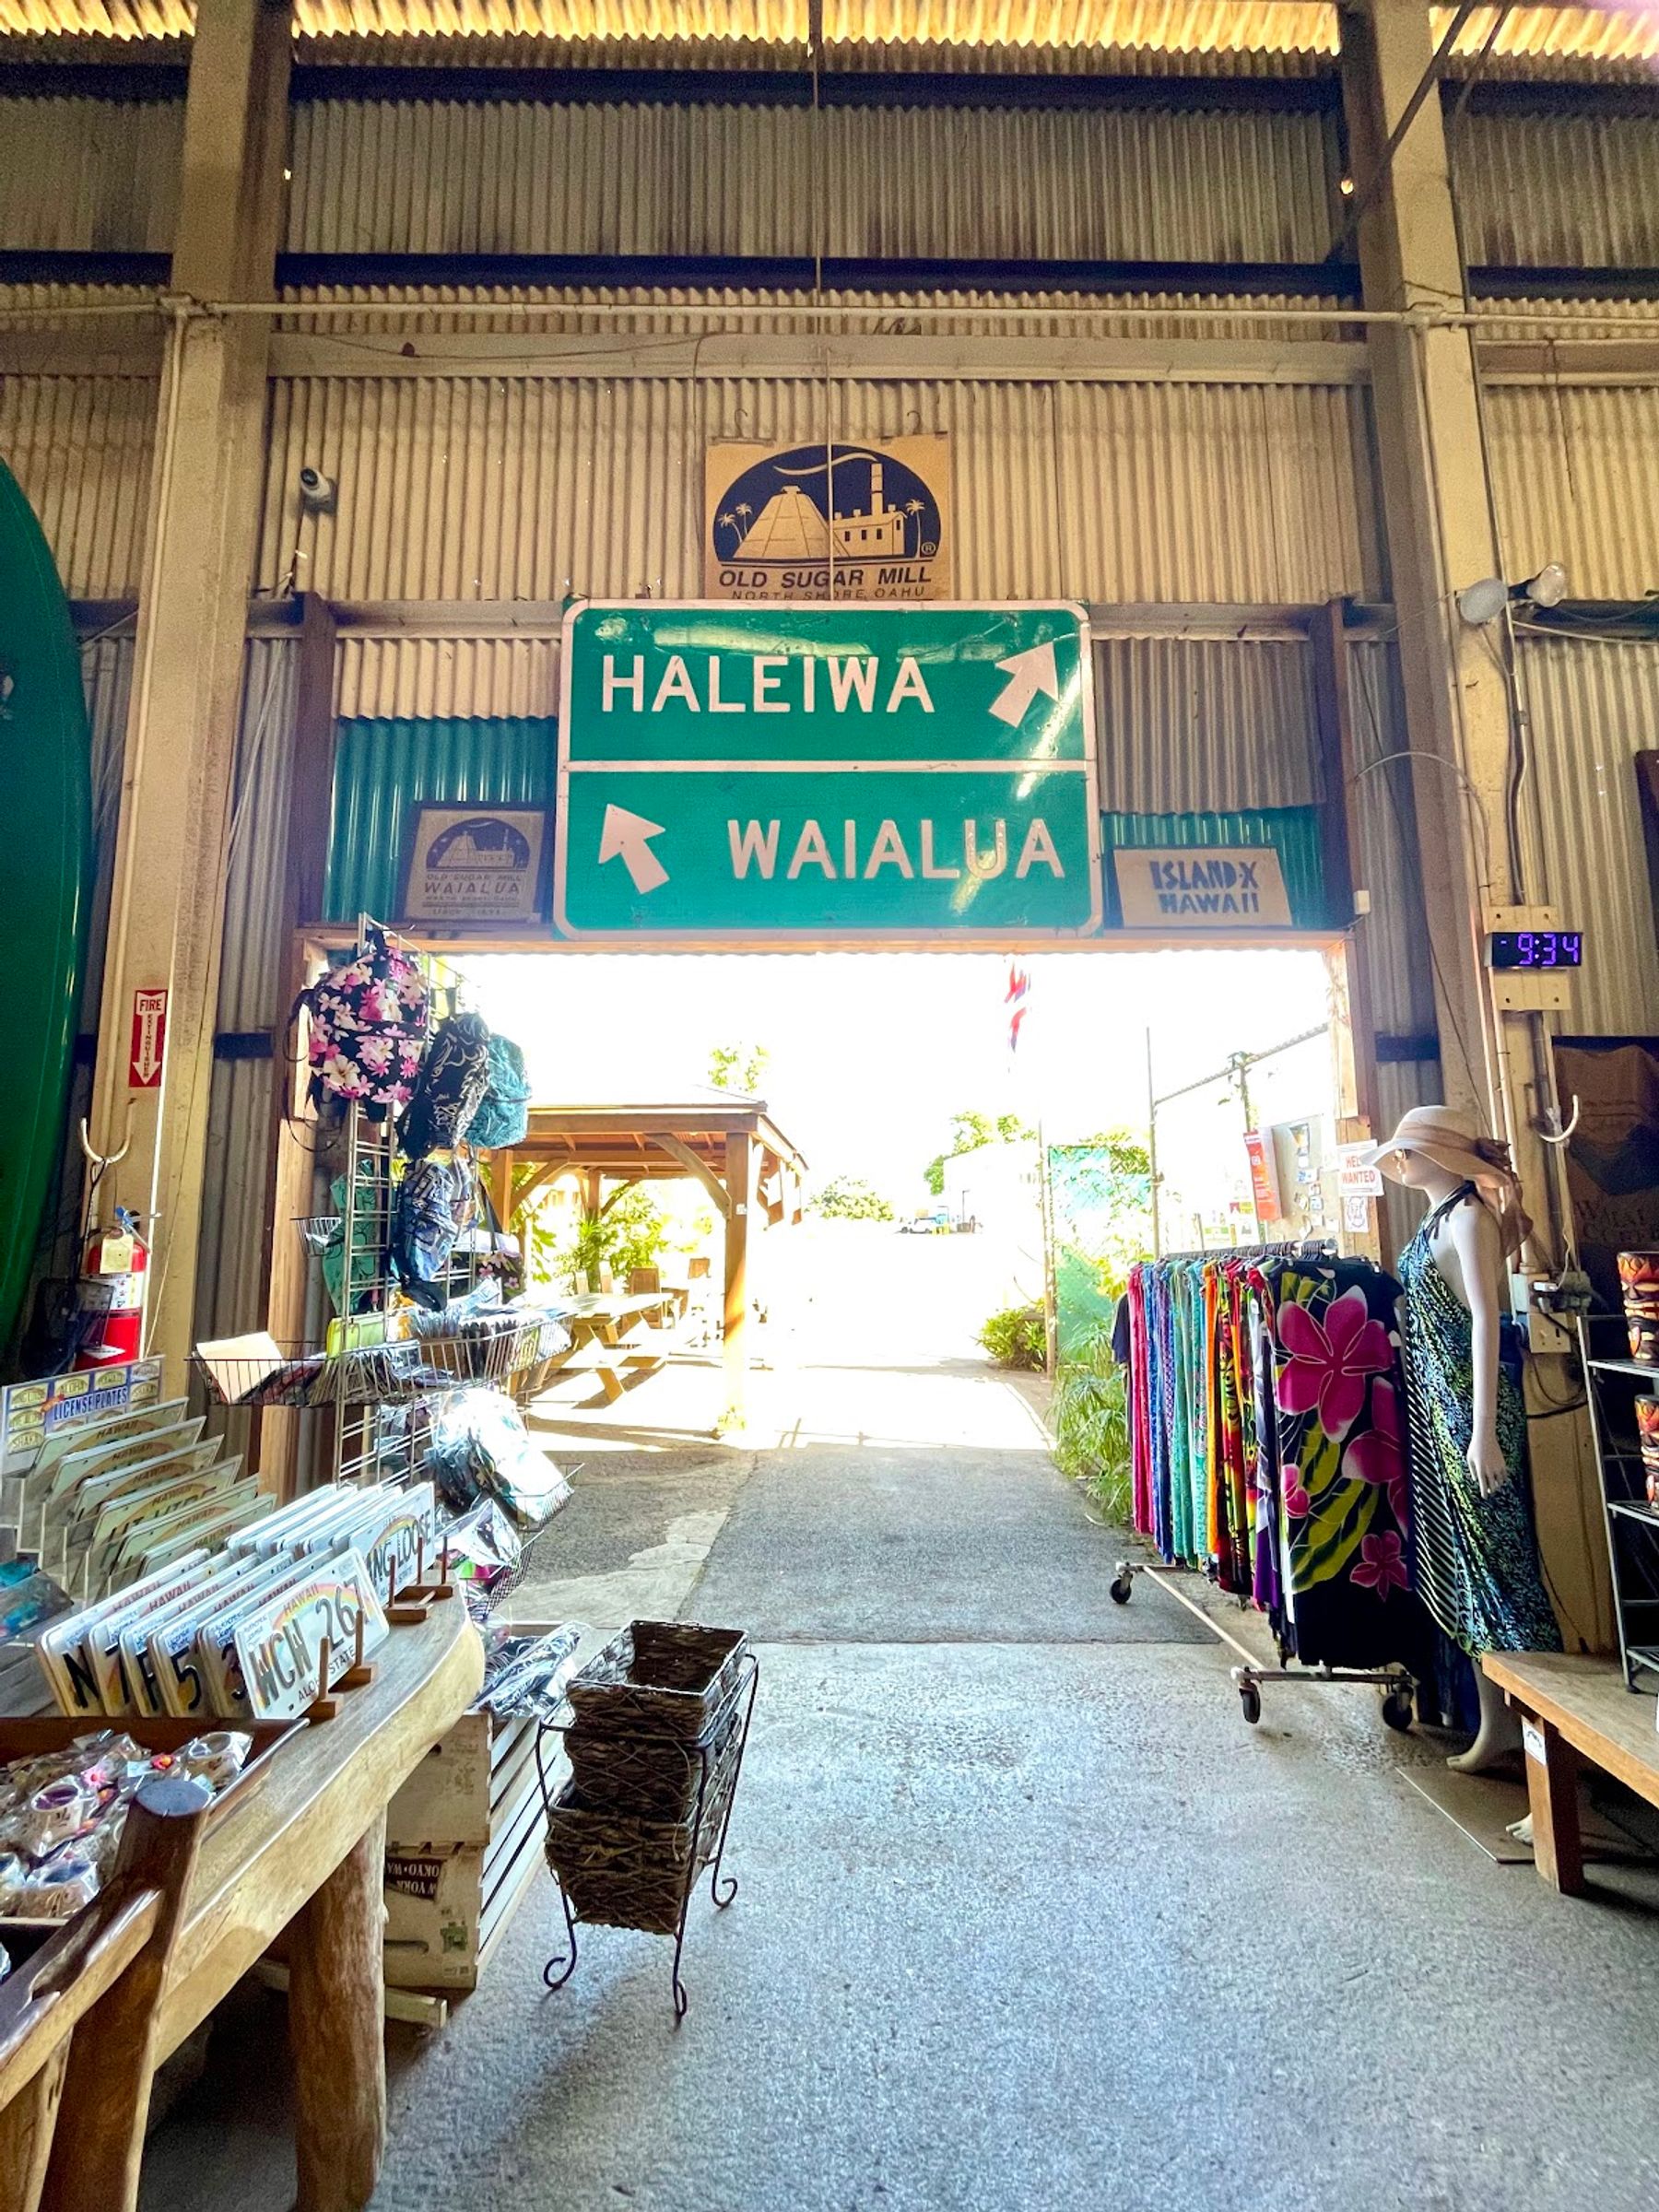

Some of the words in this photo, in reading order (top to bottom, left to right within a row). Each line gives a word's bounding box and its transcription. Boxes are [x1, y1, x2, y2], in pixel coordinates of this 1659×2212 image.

[719, 570, 768, 588] OLD
[781, 570, 865, 588] SUGAR
[878, 567, 932, 584] MILL
[731, 590, 794, 601] NORTH
[875, 586, 925, 598] OAHU
[602, 654, 935, 713] HALEIWA
[727, 818, 1065, 879] WAIALUA
[424, 882, 520, 894] WAIALUA
[1159, 892, 1260, 913] HAWAII
[1517, 933, 1579, 965] 9:34
[140, 998, 162, 1011] FIRE
[1342, 1170, 1376, 1184] WANTED
[53, 1394, 93, 1421] LICENSE
[95, 1387, 128, 1410] PLATES
[148, 1581, 193, 1612] HAWAII
[282, 1583, 320, 1617] HAWAII
[328, 1645, 357, 1675] STATE
